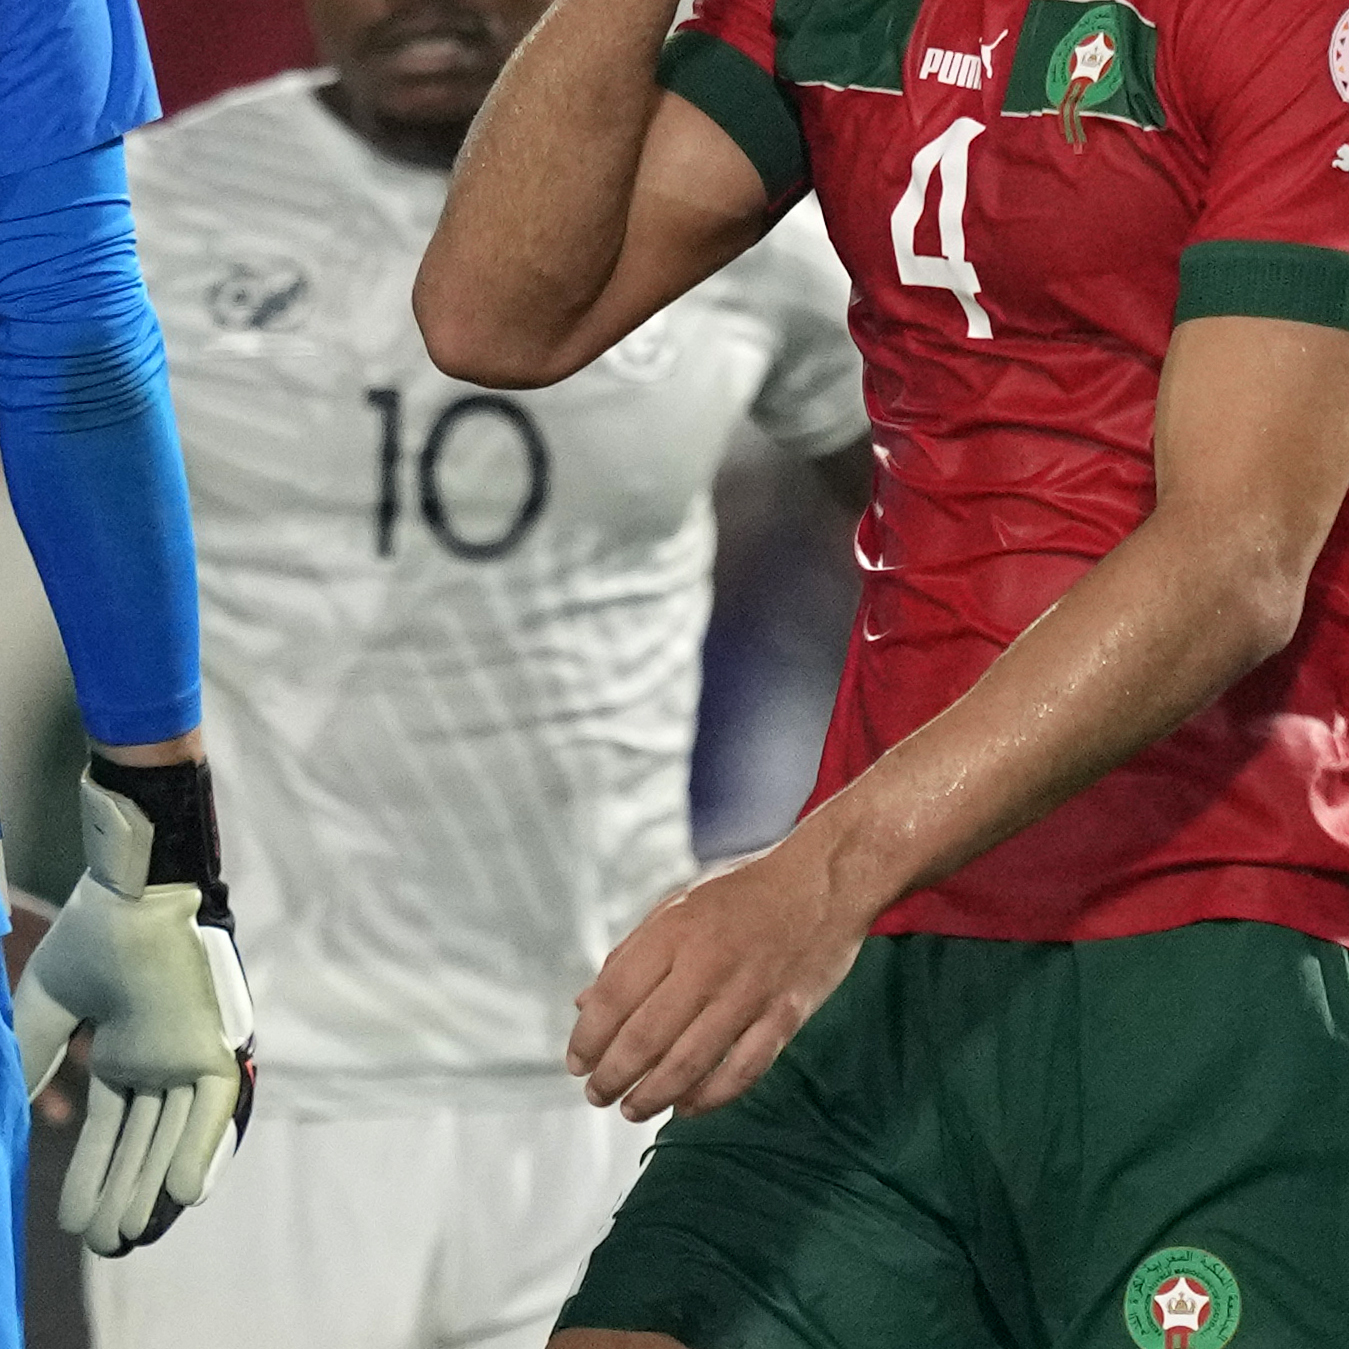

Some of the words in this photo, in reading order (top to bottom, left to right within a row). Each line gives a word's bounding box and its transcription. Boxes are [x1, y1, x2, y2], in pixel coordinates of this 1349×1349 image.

[918, 47, 982, 91] PUM
[890, 116, 994, 340] 4
[363, 386, 552, 562] 10
